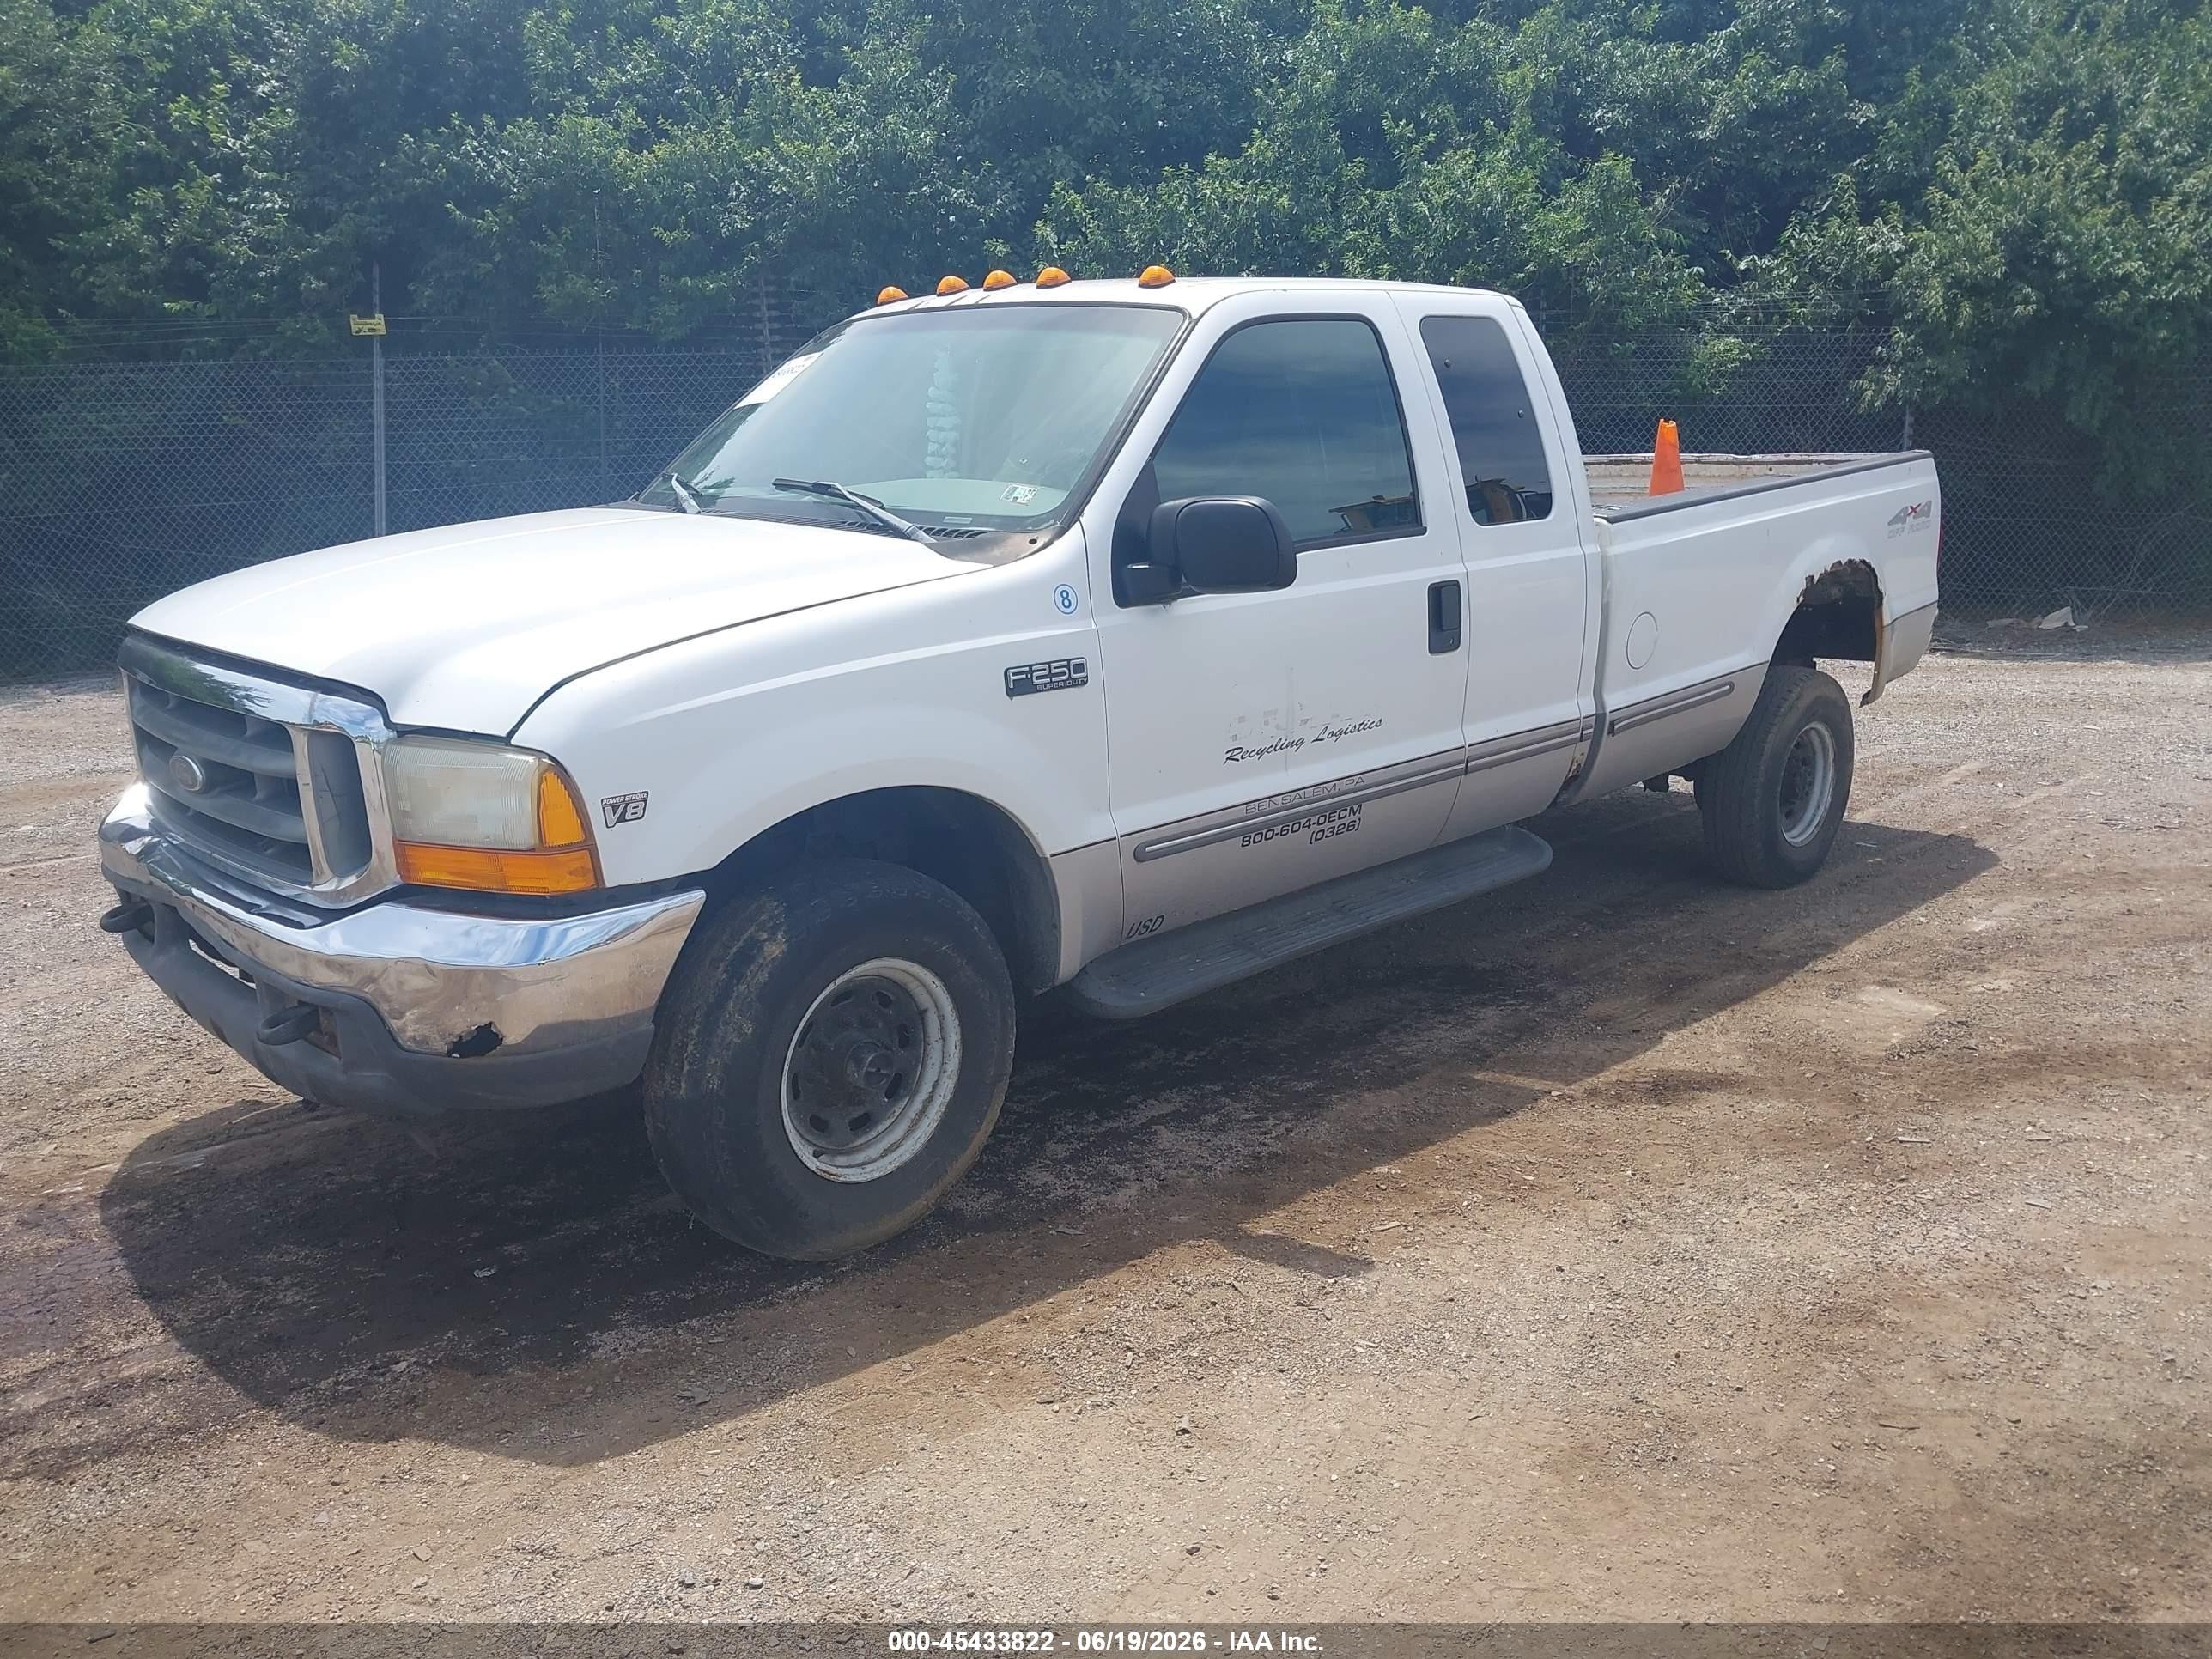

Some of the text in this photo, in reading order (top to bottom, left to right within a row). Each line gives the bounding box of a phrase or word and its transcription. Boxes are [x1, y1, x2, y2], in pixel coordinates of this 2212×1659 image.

[1060, 589, 1073, 609] 8
[1036, 677, 1088, 691] SUPER DUTY
[1223, 718, 1383, 765] Recycling Logistics
[602, 792, 648, 805] POWER STROKE
[1245, 776, 1365, 815] BENSALEM, PA
[604, 801, 646, 827] V8
[1309, 817, 1362, 845] (0326)
[1126, 915, 1165, 939] USD
